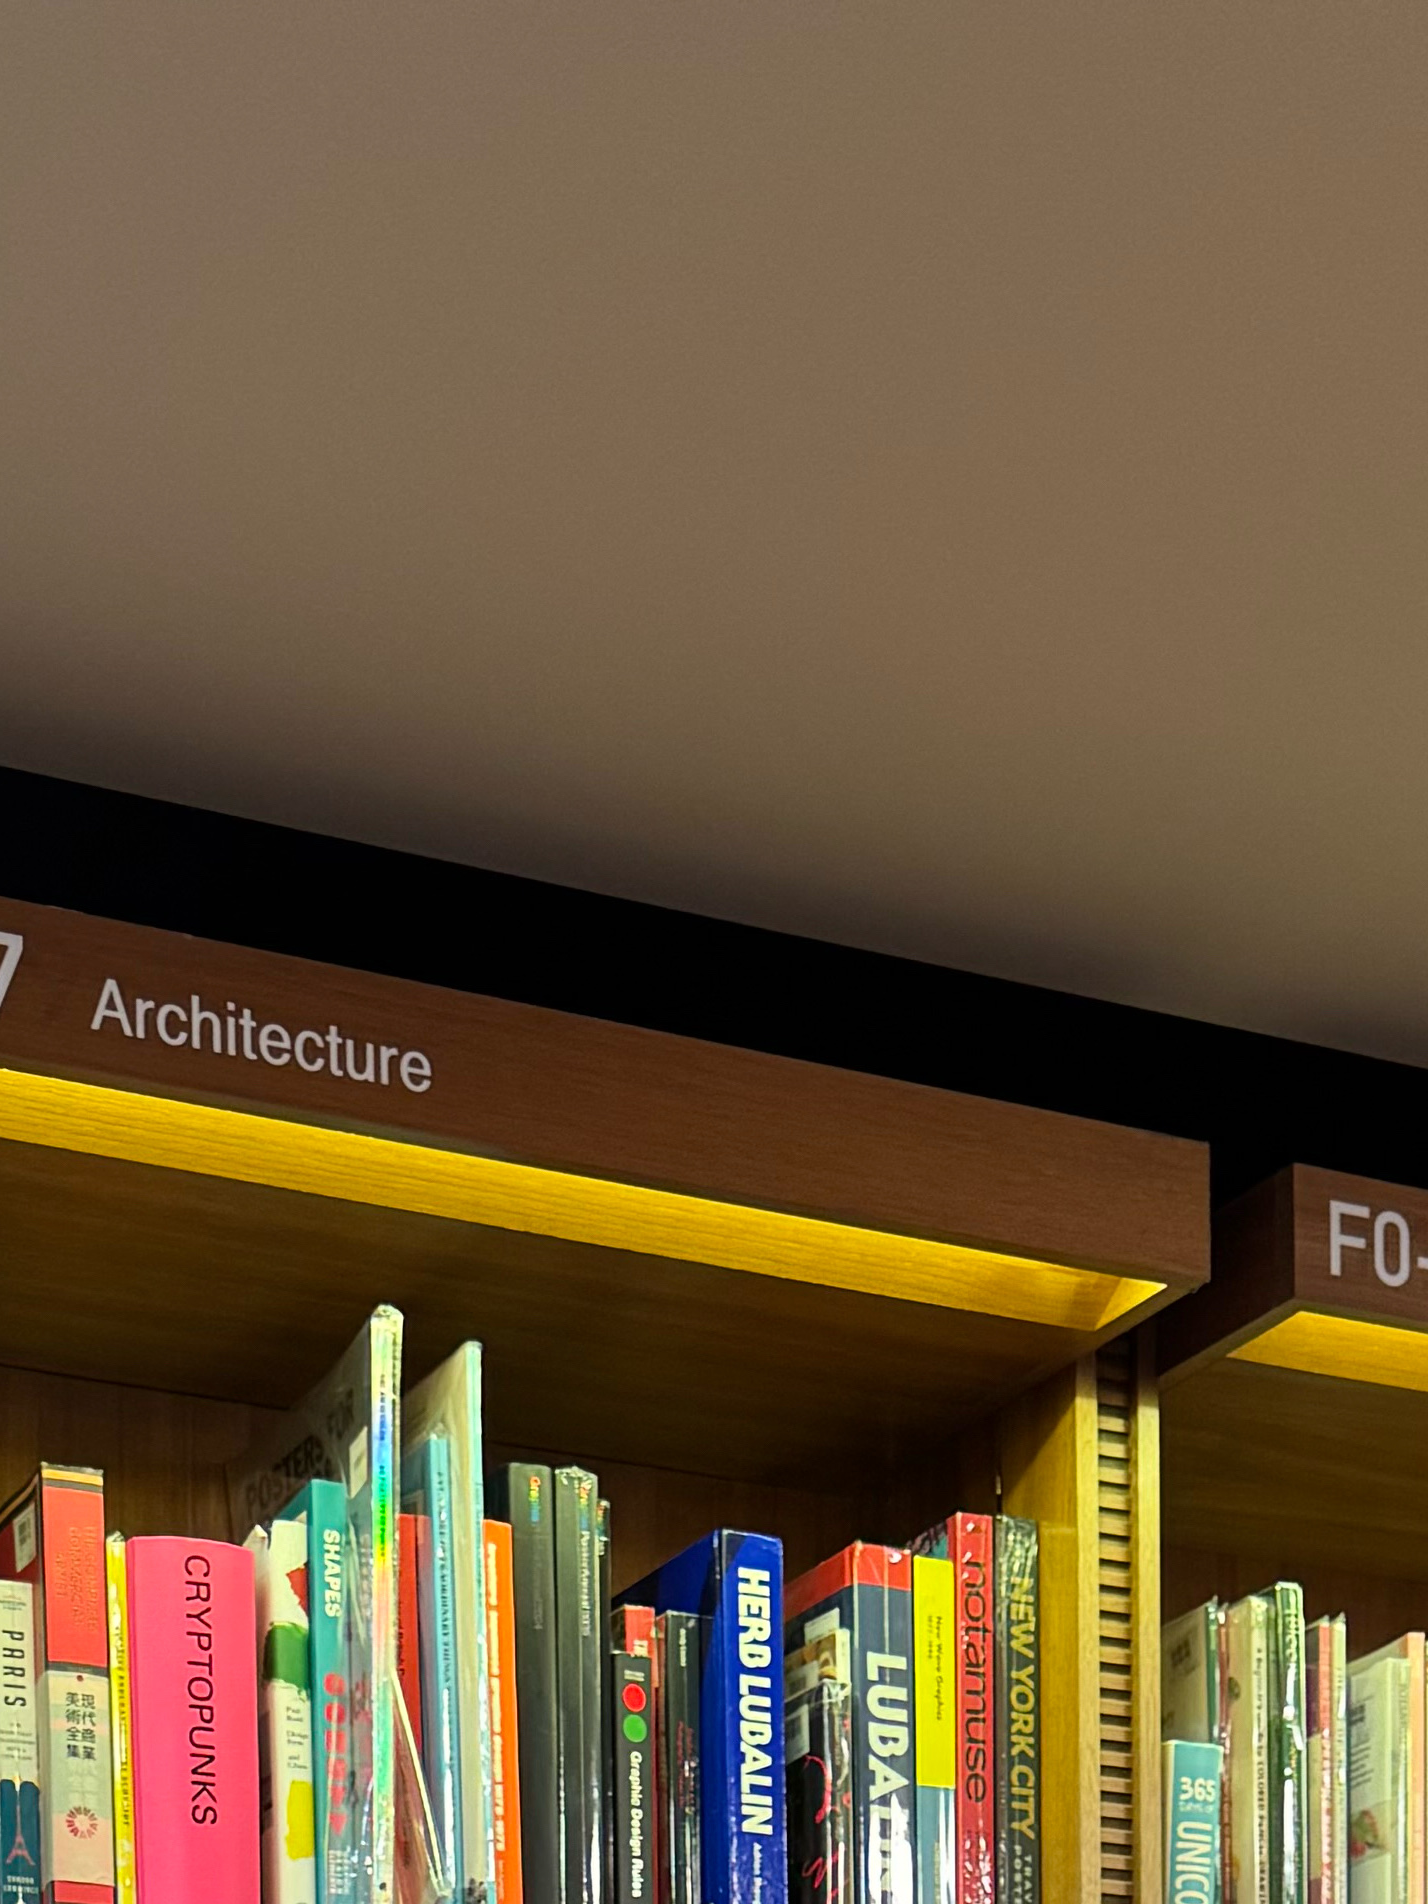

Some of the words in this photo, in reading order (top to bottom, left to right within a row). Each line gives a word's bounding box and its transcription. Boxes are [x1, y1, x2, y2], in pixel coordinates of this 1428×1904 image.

[90, 978, 433, 1094] Architecture
[322, 1529, 343, 1619] SHAPES
[737, 1567, 772, 1668] HERB
[1009, 1576, 1035, 1656] NEW
[2, 1629, 27, 1709] PARIS
[184, 1554, 218, 1826] CRYPTOPUNKS
[962, 1560, 990, 1804] notamuse
[1010, 1657, 1036, 1761] YORK
[629, 1751, 644, 1790] Graphic
[739, 1675, 774, 1835] LUBALIN
[1179, 1776, 1216, 1803] 365
[630, 1792, 644, 1844] Design
[1010, 1765, 1037, 1840] CITY
